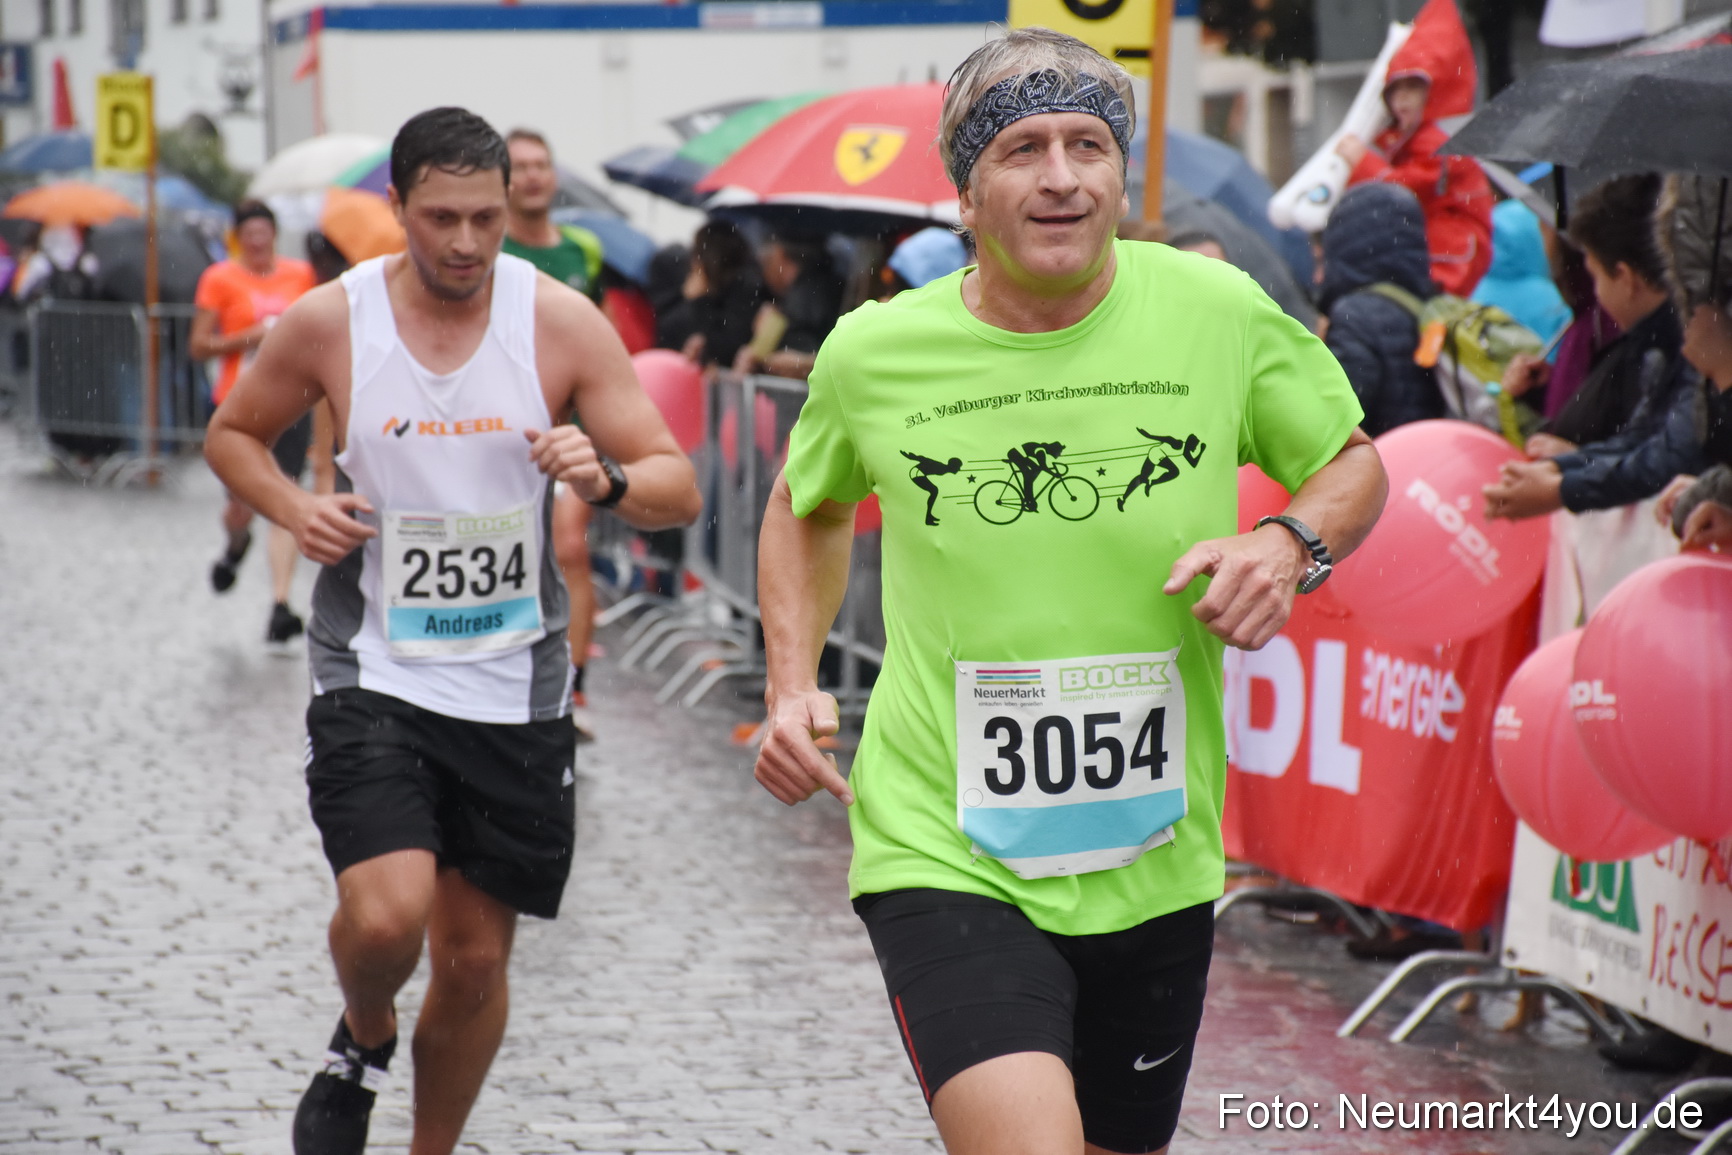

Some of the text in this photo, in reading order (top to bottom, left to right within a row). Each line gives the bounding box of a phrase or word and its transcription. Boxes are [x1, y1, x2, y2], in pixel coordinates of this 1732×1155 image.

[1026, 85, 1047, 99] Buff
[109, 102, 141, 150] D
[905, 380, 1190, 430] 31. Velburger Kirchweihtriathlon
[417, 417, 513, 436] KLEBL
[456, 510, 524, 535] BOCK
[402, 542, 526, 600] 2534
[424, 611, 504, 635] Andreas
[1060, 661, 1171, 693] BOCK
[974, 687, 1046, 699] NeuerMarkt
[1060, 686, 1173, 703] inspired by smart concepts
[1570, 679, 1616, 708] DL
[1223, 634, 1362, 796] DL
[983, 707, 1169, 796] 3054
